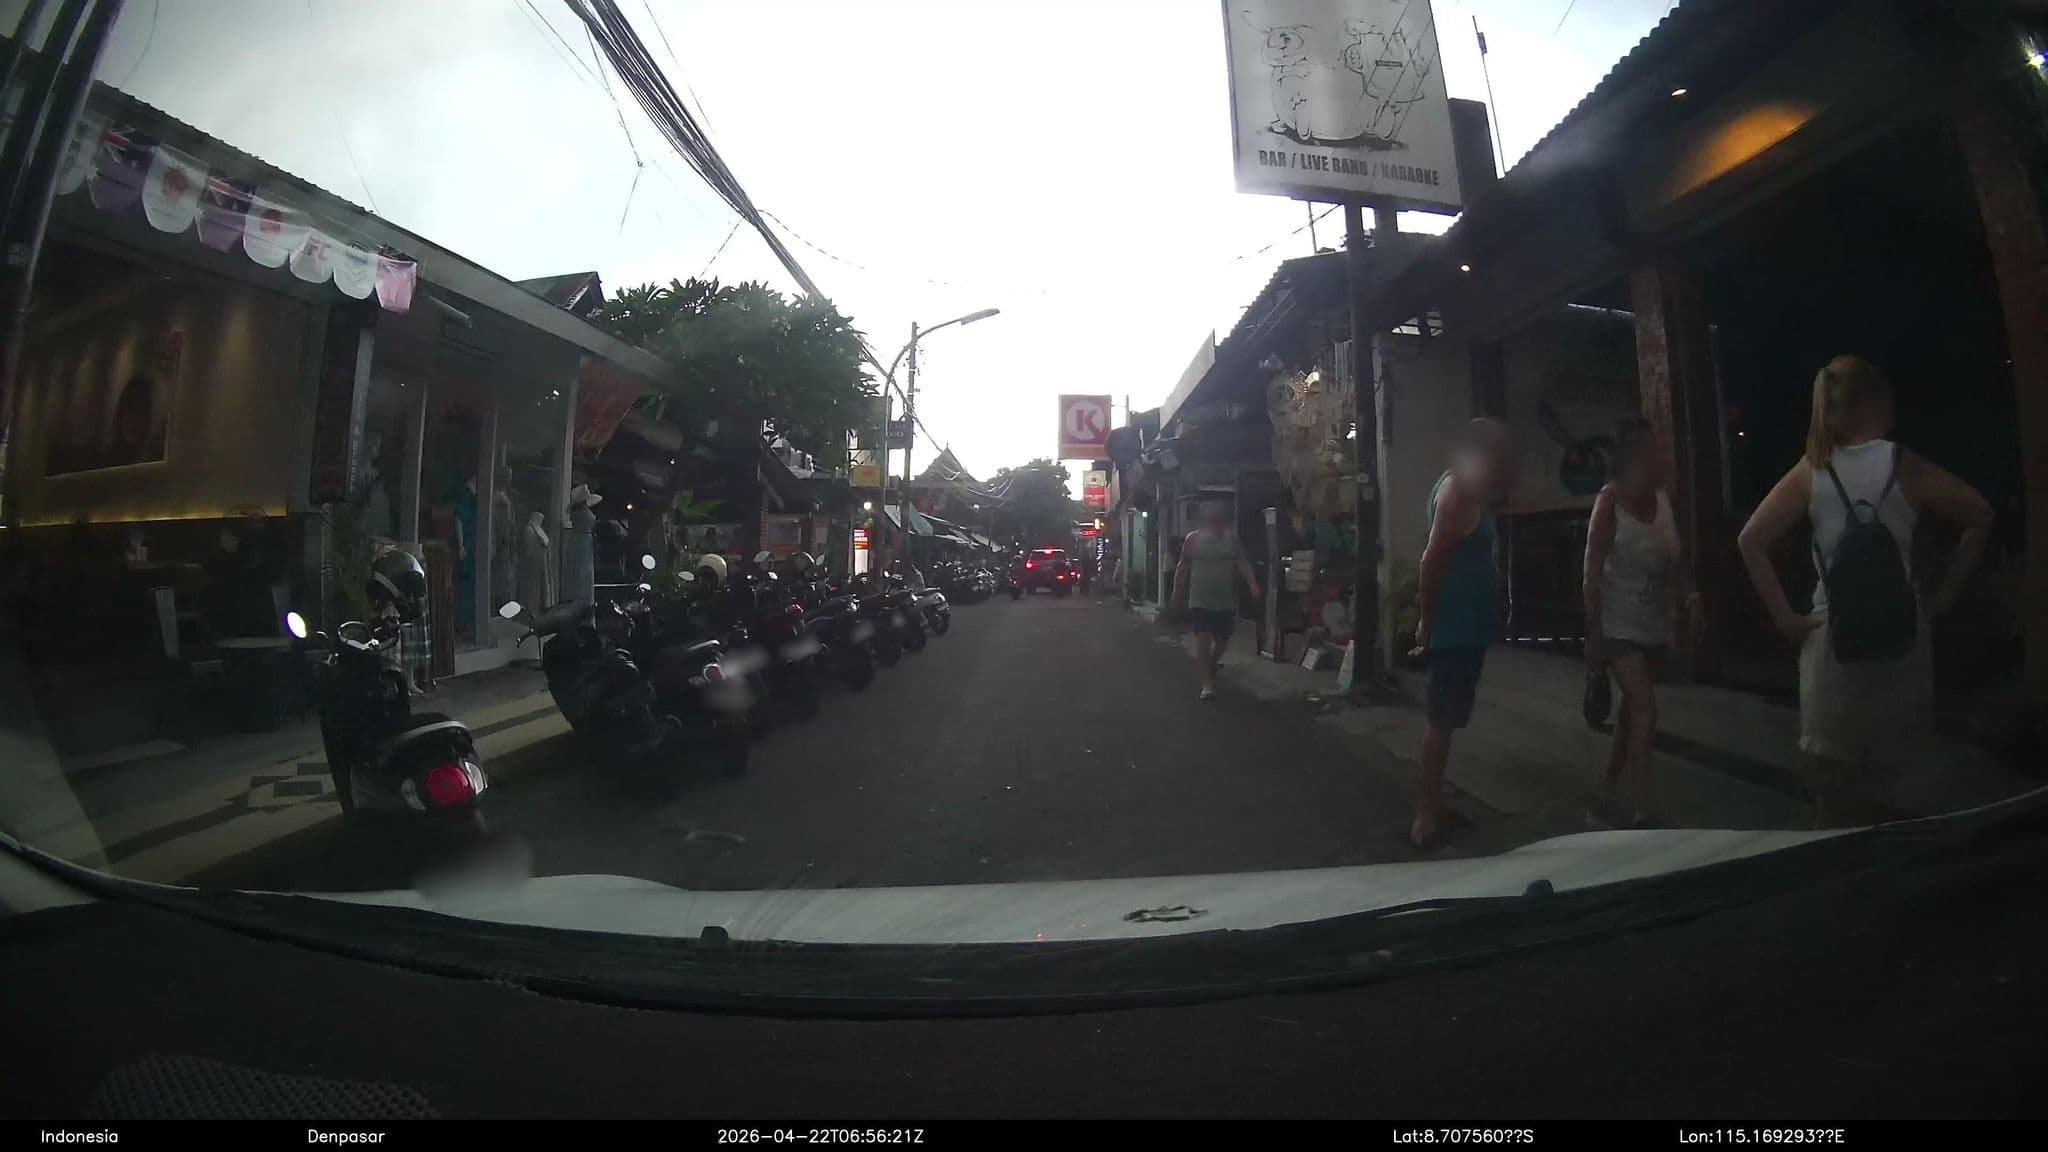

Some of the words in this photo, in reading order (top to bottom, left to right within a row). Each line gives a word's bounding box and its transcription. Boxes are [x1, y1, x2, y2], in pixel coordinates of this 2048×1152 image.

[1258, 149, 1287, 168] BAR
[1300, 153, 1330, 172] LIVE
[1332, 157, 1369, 176] BAND
[1380, 162, 1441, 187] KARAOKE
